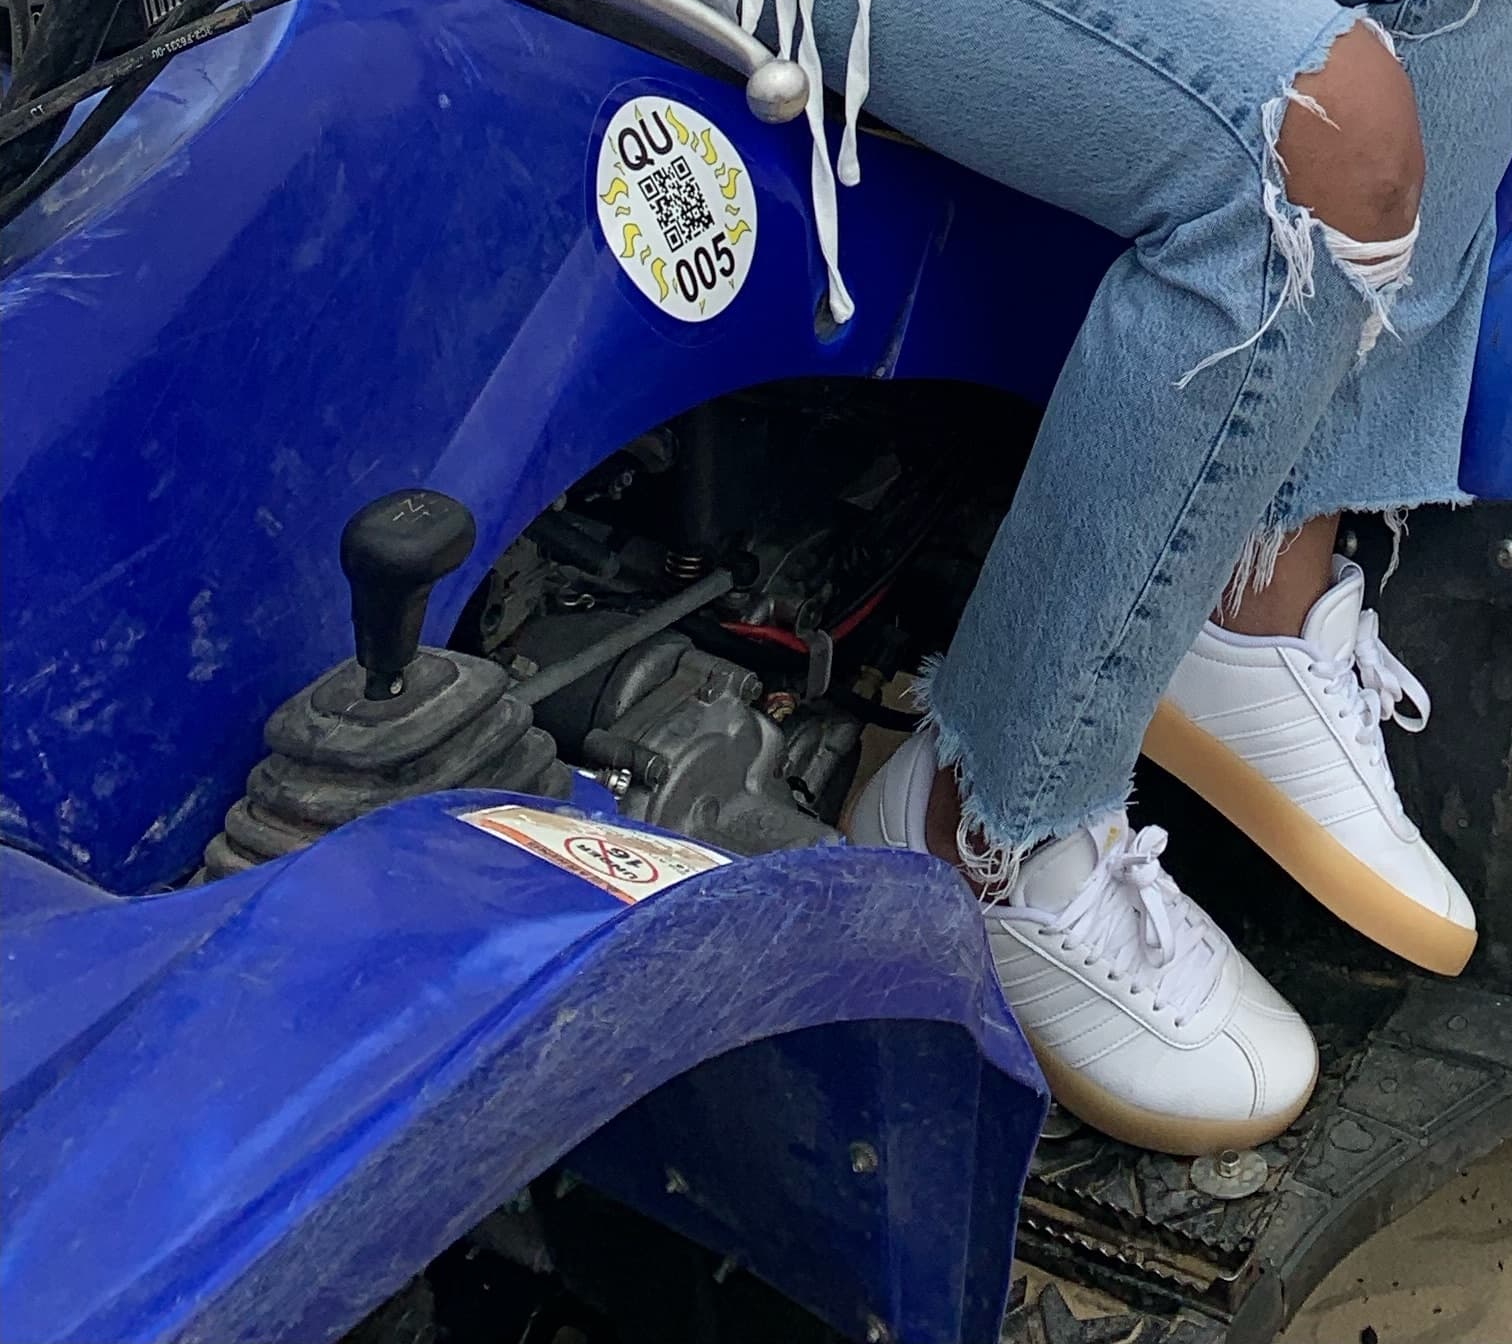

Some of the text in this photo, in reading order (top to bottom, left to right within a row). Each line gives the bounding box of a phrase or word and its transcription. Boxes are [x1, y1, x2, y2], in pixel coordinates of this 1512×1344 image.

[618, 111, 674, 171] QU
[675, 232, 736, 303] 005
[608, 846, 642, 870] 16
